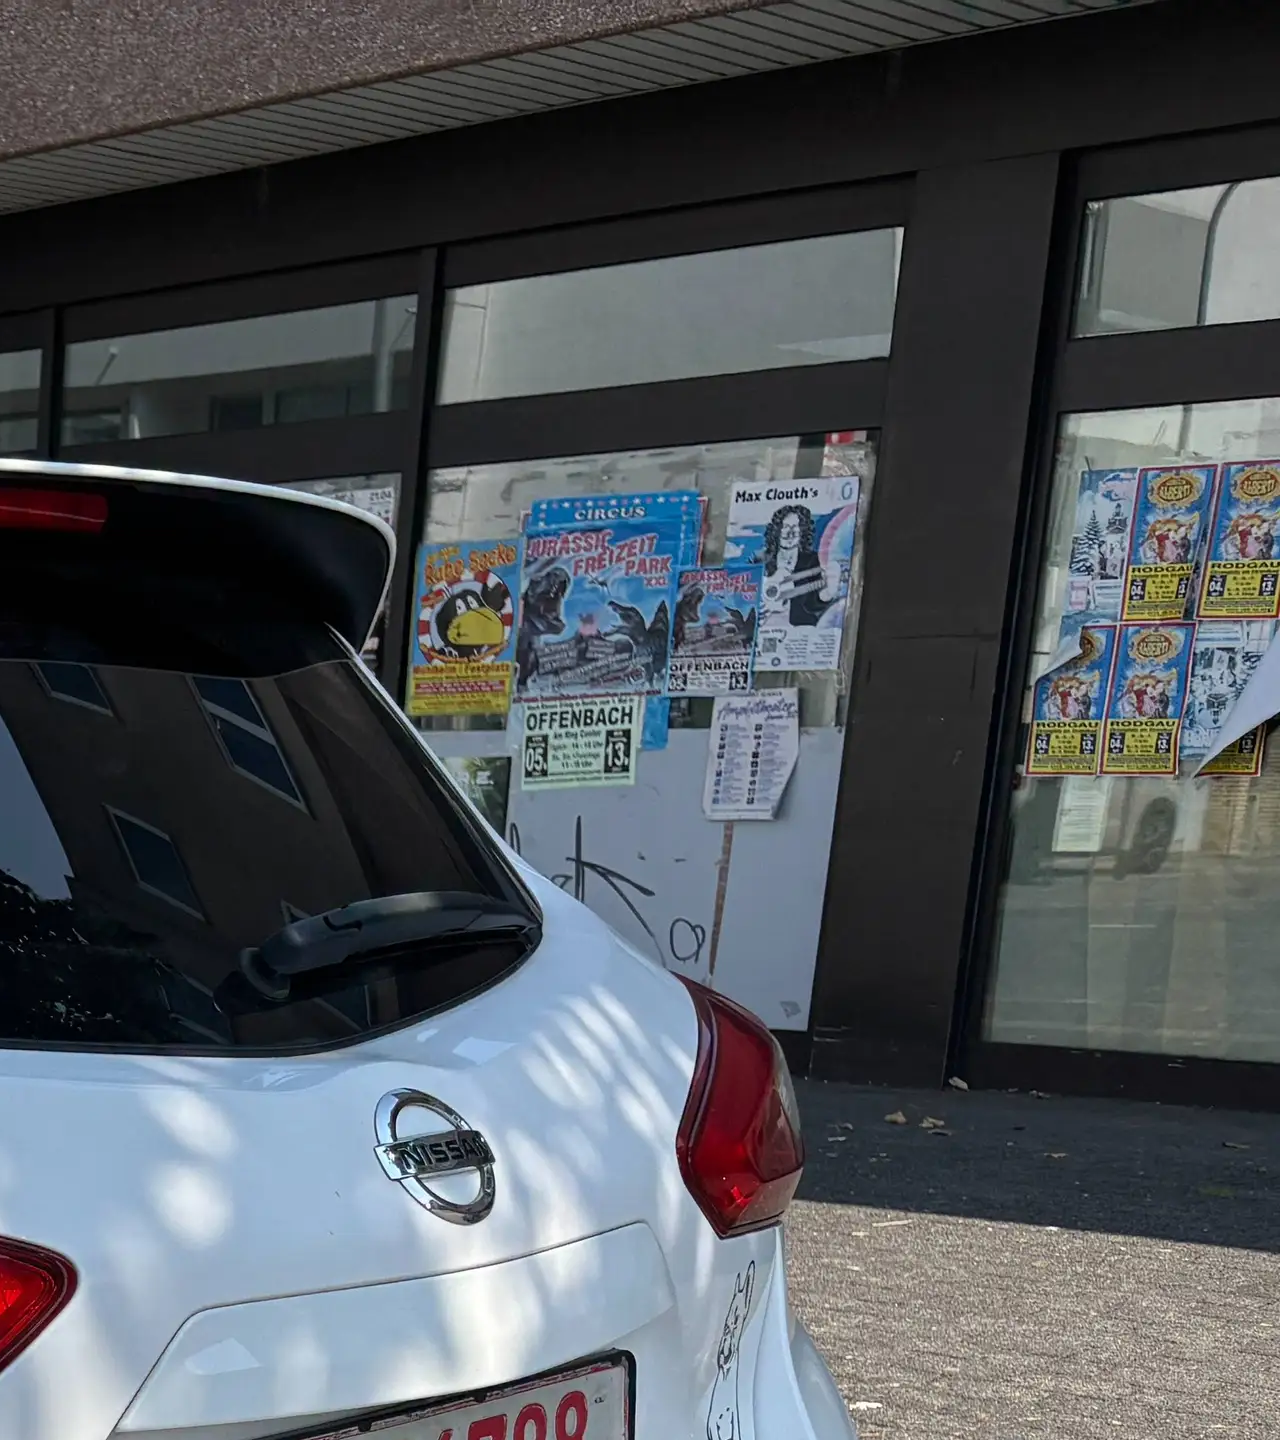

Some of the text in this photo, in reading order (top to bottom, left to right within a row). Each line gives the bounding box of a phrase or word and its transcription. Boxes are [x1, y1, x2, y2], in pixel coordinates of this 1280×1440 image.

[735, 486, 819, 503] Max Clouth's
[574, 506, 647, 521] CIRCUS
[527, 529, 614, 558] JURASSIC
[573, 533, 659, 577] FREIZEIT
[624, 555, 673, 577] PARK
[670, 661, 749, 673] OFFENBACH
[526, 705, 633, 731] OFFENBACH
[526, 746, 548, 773] 05.
[606, 741, 629, 768] 13.
[398, 1136, 489, 1175] NISSAN
